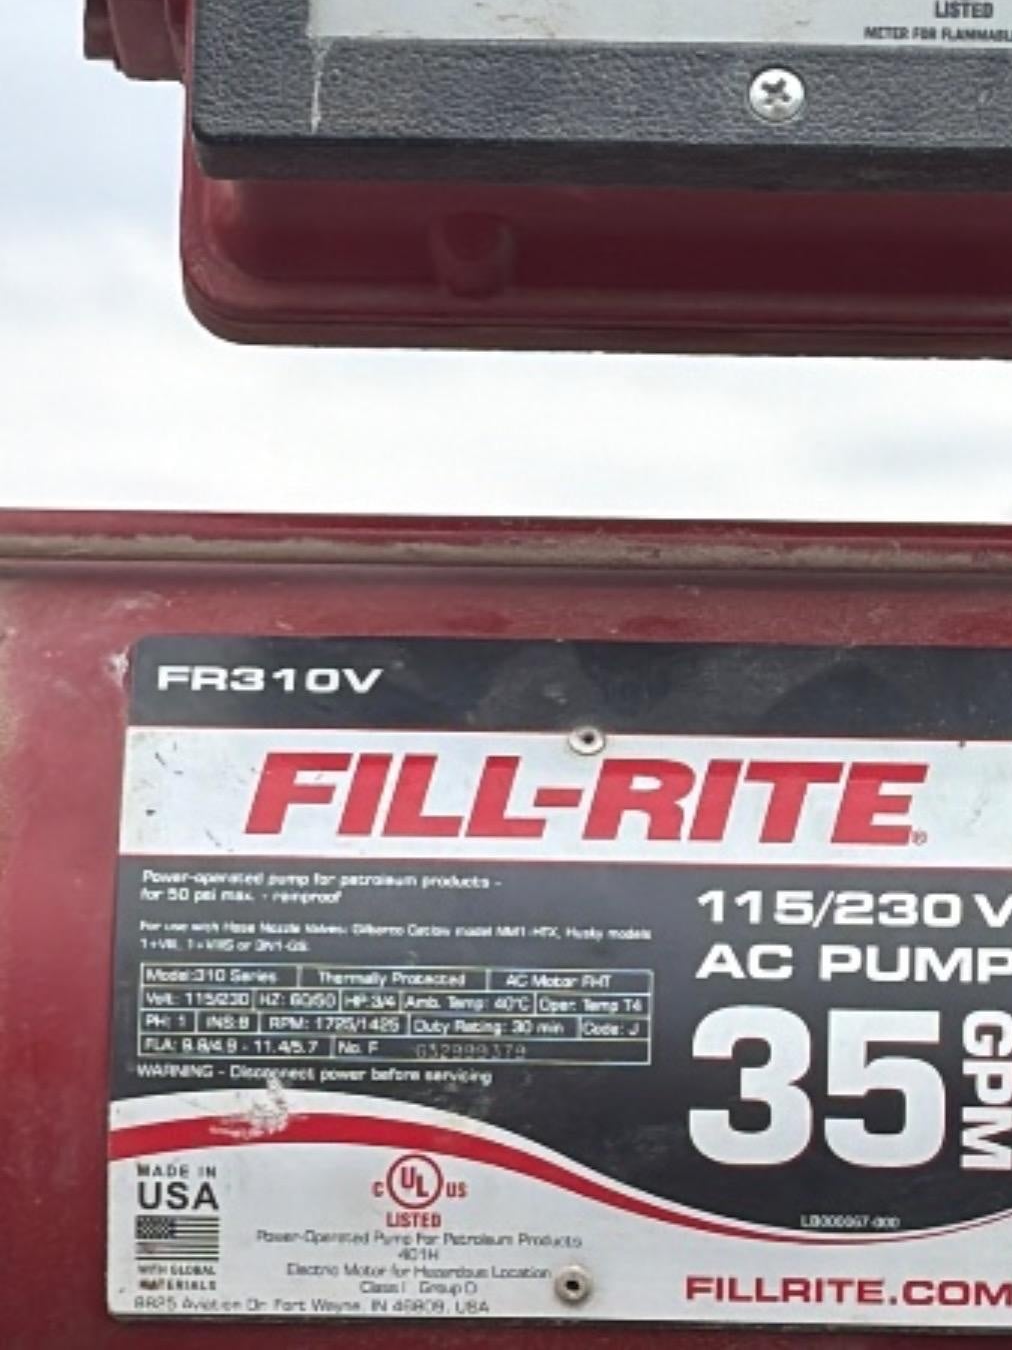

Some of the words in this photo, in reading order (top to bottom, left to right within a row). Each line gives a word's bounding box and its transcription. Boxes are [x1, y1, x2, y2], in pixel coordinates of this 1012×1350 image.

[934, 0, 994, 19] LISTED
[864, 26, 909, 41] METER
[912, 26, 937, 41] FOR
[157, 666, 384, 694] FR310V
[142, 870, 265, 885] Power-operated
[267, 873, 310, 886] pump
[313, 873, 336, 885] for
[340, 873, 418, 887] petroleum
[421, 876, 490, 889] products
[140, 888, 164, 901] for
[167, 888, 189, 900] 50
[194, 888, 217, 903] psi
[697, 890, 962, 928] 115/230
[566, 926, 604, 941] Husky
[695, 944, 794, 980] AC
[229, 968, 277, 983] Series
[317, 971, 388, 988] Thermally
[391, 971, 466, 985] Protected
[505, 973, 530, 988] AC
[531, 974, 579, 988] Motor
[259, 992, 287, 1007] HZ:
[404, 994, 442, 1009] Amb.
[268, 1016, 311, 1031] RPM:
[413, 1019, 450, 1036] Duty
[454, 1019, 509, 1037] Rating:
[511, 1020, 532, 1035] 30
[535, 1020, 565, 1035] min
[582, 1021, 625, 1036] Code:
[627, 1022, 640, 1036] J
[136, 1063, 214, 1079] WARNING
[229, 1065, 316, 1081] Disconnect
[318, 1069, 367, 1084] power
[370, 1067, 421, 1083] before
[423, 1069, 494, 1086] servicing
[688, 1004, 947, 1169] 35
[137, 1163, 189, 1178] MADE
[198, 1166, 218, 1179] IN
[401, 1165, 430, 1198] UL
[445, 1180, 468, 1199] US
[137, 1181, 220, 1211] USA
[386, 1211, 442, 1229] LISTED
[256, 1228, 370, 1246] Power-Operated
[373, 1230, 413, 1248] Pump
[443, 1232, 514, 1247] Petroleum
[518, 1232, 584, 1249] Products
[138, 1264, 168, 1277] WITH
[170, 1264, 217, 1277] GLOBAL
[286, 1261, 340, 1277] Electric
[343, 1262, 386, 1277] Motor
[391, 1263, 412, 1277] for
[413, 1264, 490, 1280] Hazardous
[491, 1264, 552, 1280] Location
[138, 1277, 217, 1291] MATERIALS
[359, 1280, 399, 1295] Class
[418, 1280, 464, 1297] Group
[181, 1297, 242, 1313] Aviation
[274, 1298, 306, 1312] Fort
[454, 1299, 491, 1315] USA
